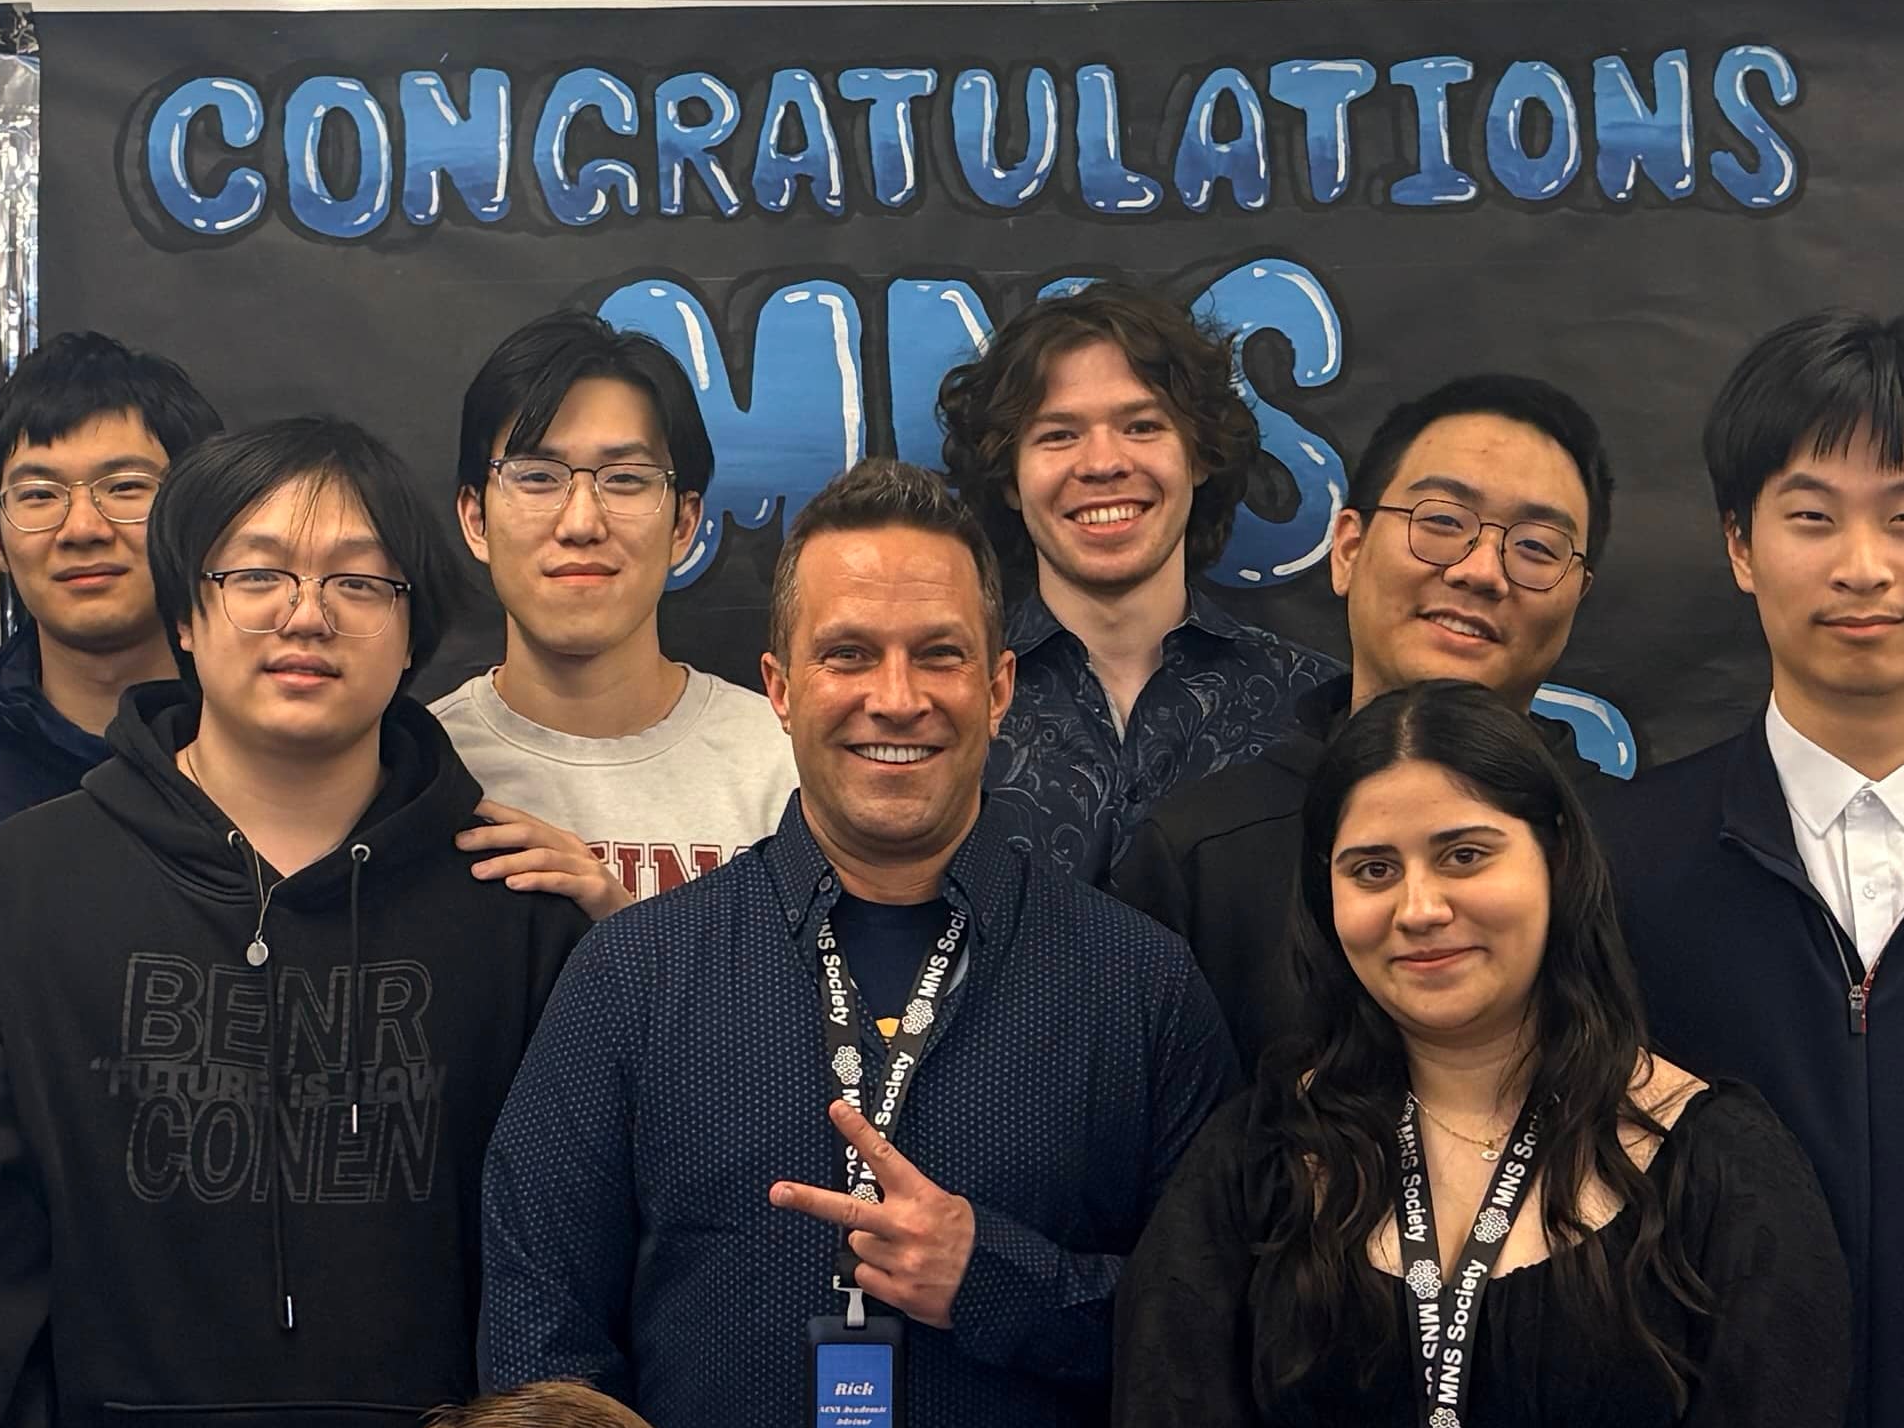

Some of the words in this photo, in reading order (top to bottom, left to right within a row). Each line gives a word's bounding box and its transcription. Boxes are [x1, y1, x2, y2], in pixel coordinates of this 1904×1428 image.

[144, 44, 1802, 240] CONGRATULATIONS
[817, 918, 836, 951] NS
[917, 954, 949, 998] MNS
[937, 907, 968, 953] Soci
[121, 952, 432, 1072] BENR
[821, 953, 848, 1027] Society
[875, 1051, 915, 1127] Society
[126, 1089, 441, 1205] CONEN
[1491, 1160, 1526, 1207] MNS
[1401, 1173, 1427, 1243] Society
[1446, 1258, 1487, 1343] Society
[835, 1381, 874, 1396] Rick
[1437, 1346, 1463, 1405] MNS
